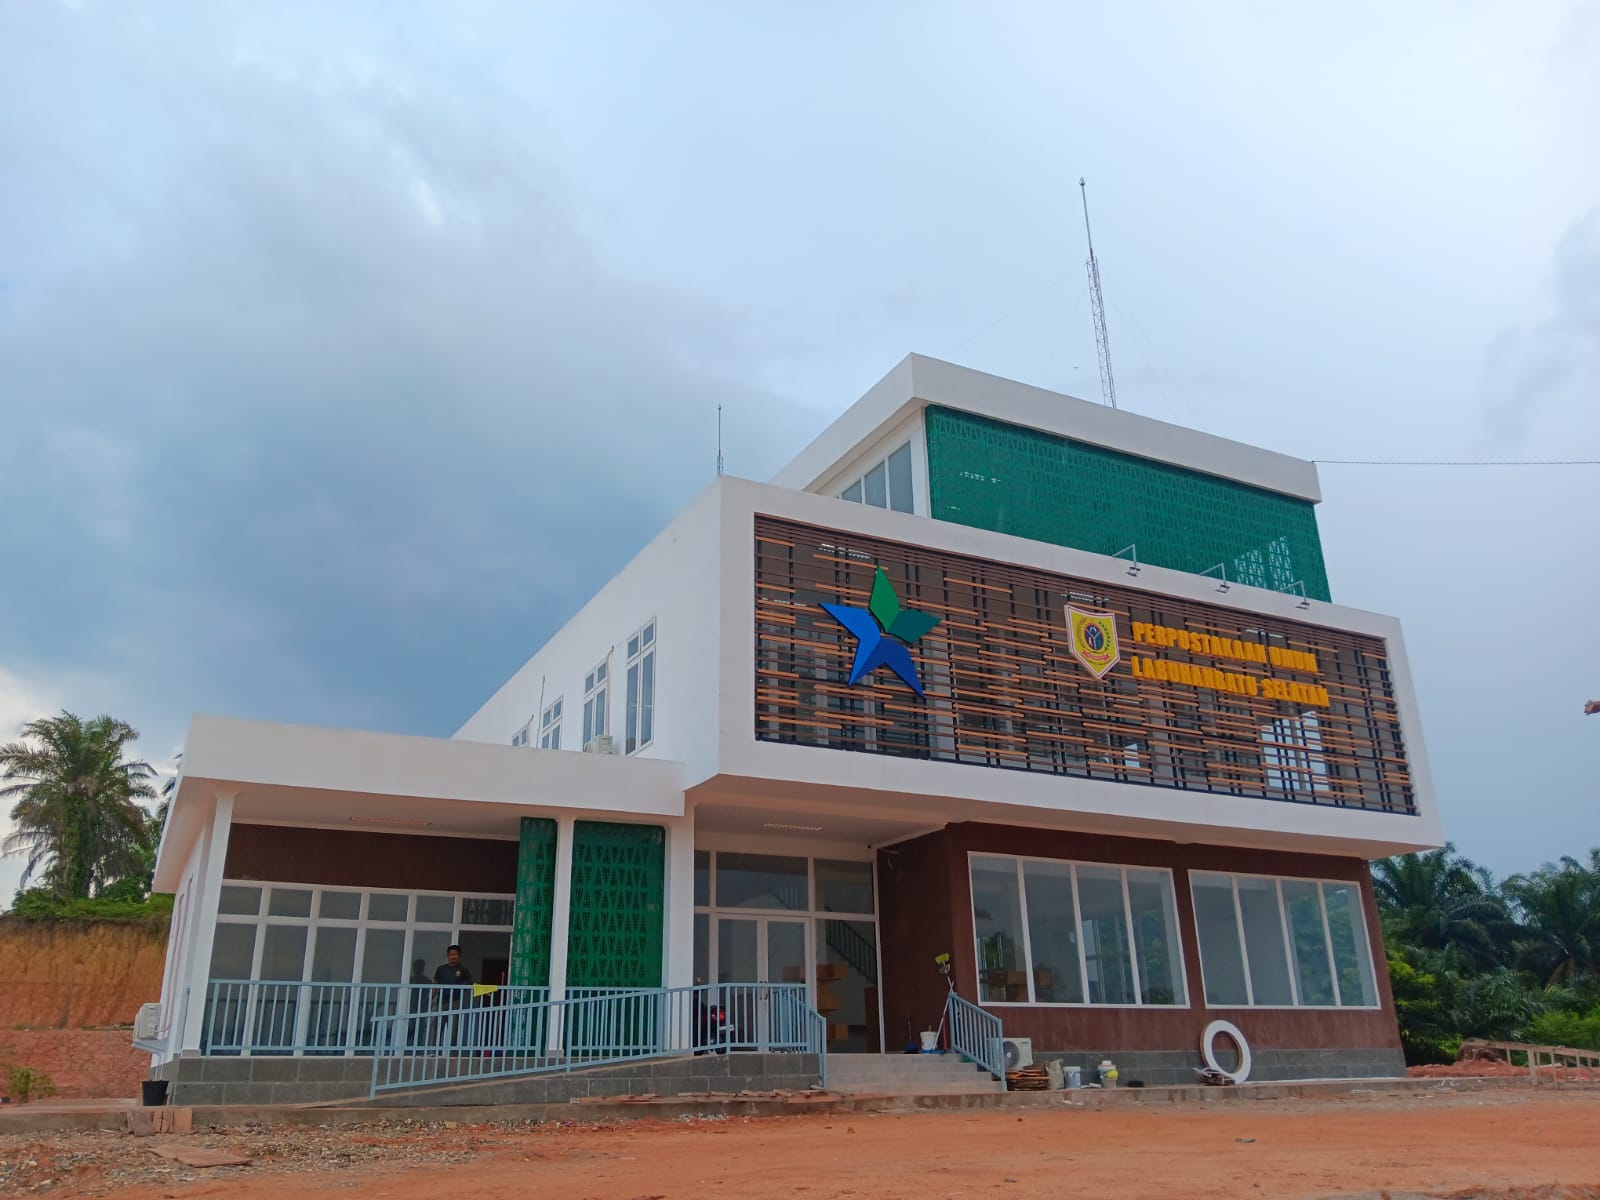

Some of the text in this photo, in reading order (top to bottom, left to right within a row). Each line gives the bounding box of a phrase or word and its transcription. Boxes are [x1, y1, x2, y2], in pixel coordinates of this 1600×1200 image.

[1132, 622, 1318, 673] PERPUSTAKAAN UMUM
[1131, 656, 1330, 707] LABUHANBATU SELATAN
